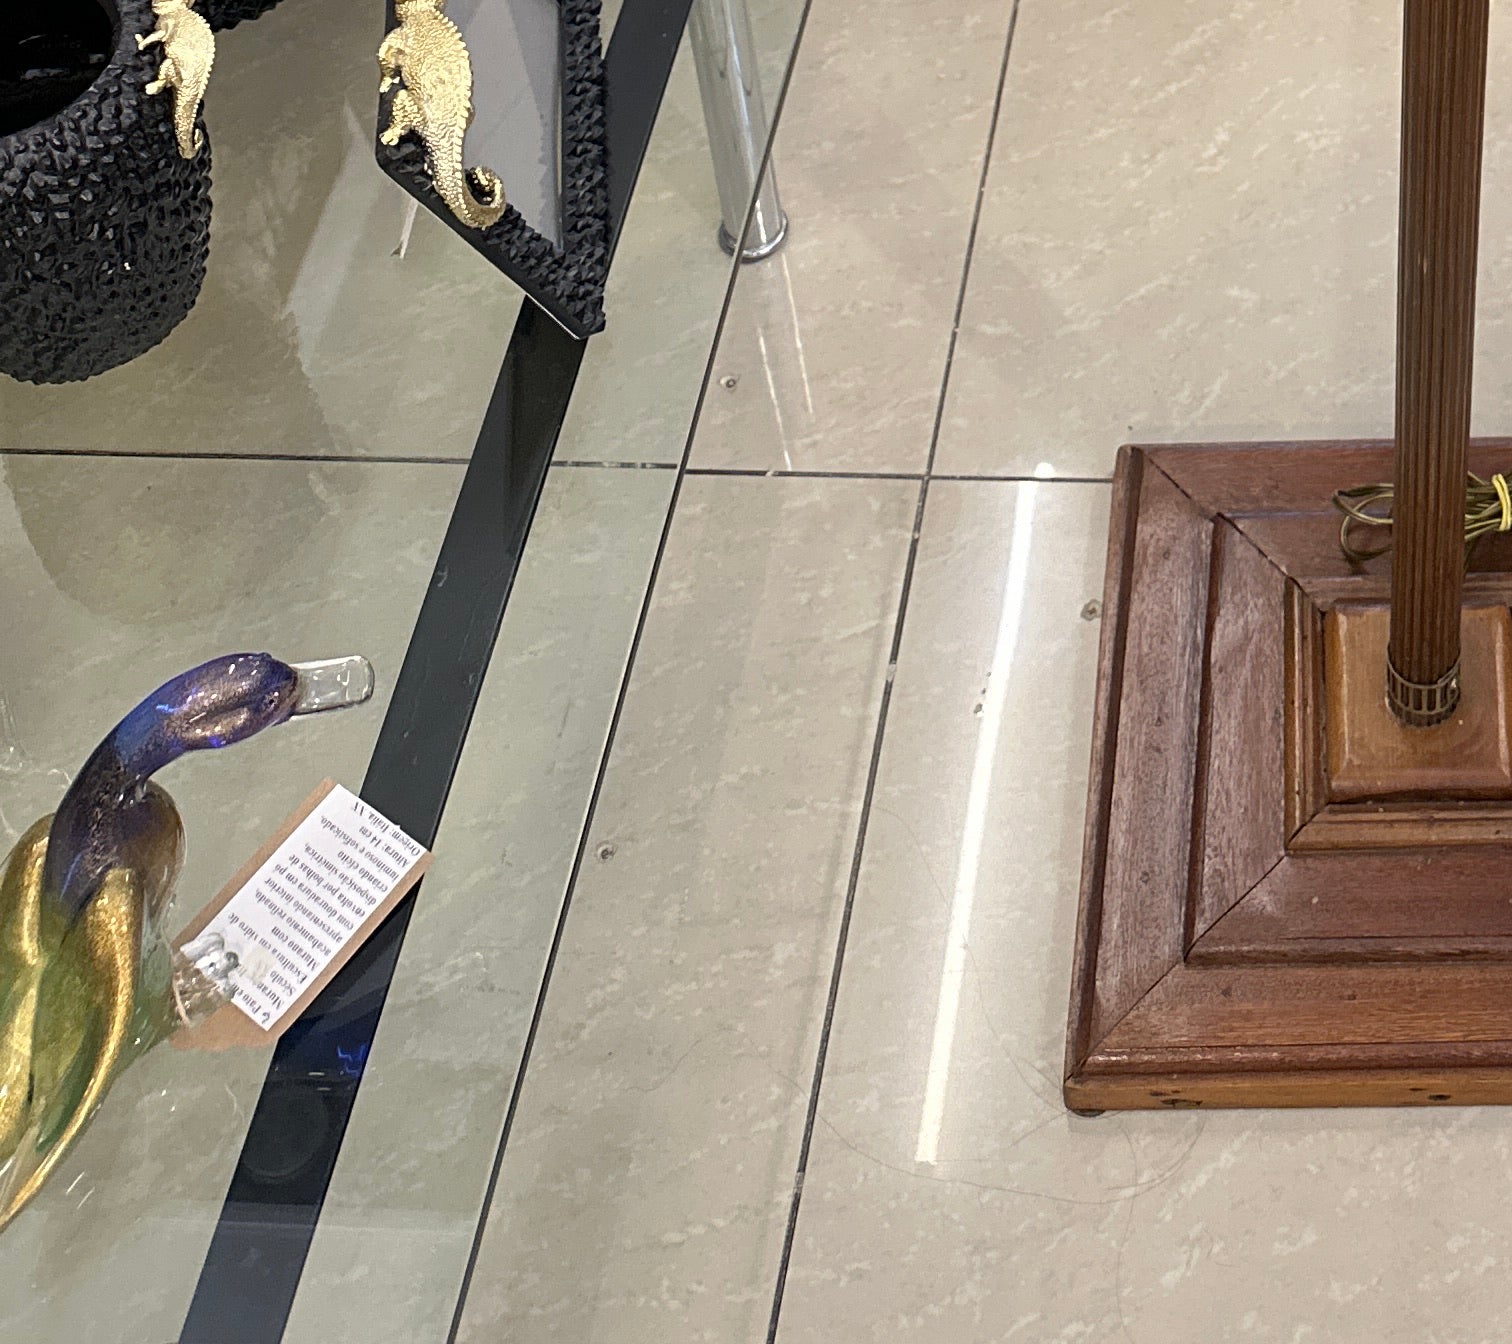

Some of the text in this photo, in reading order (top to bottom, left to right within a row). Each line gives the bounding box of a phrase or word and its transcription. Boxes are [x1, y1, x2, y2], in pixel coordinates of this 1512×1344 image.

[358, 825, 409, 868] Altura: 14 cm
[358, 846, 366, 854] e
[336, 850, 388, 893] criando efeito
[363, 850, 400, 883] luminoso
[272, 863, 354, 931] com douradura em pó
[288, 853, 366, 918] envolta por bolhas de
[337, 872, 377, 906] disposição
[227, 912, 240, 925] de
[263, 877, 343, 944] apresentando interior
[237, 920, 259, 941] vidro
[257, 937, 272, 950] em
[270, 925, 289, 943] com
[285, 916, 332, 956] acabamento
[270, 947, 308, 985] Escultura
[286, 939, 317, 972] Murano
[255, 980, 282, 1010] Muran
[269, 969, 296, 997] Século
[241, 993, 262, 1015] Pato
